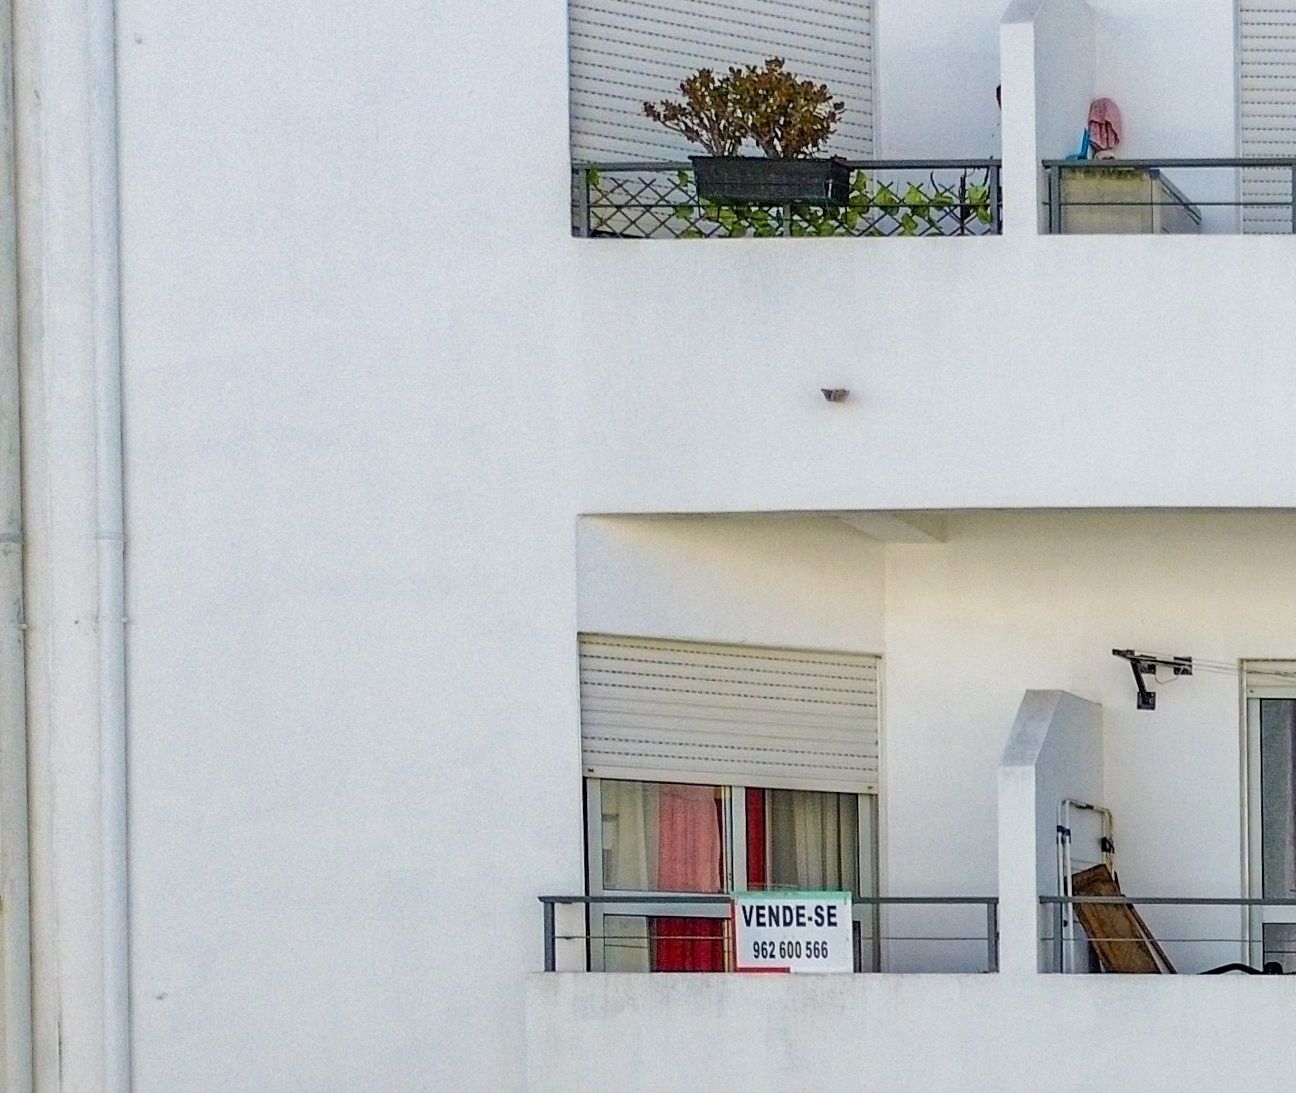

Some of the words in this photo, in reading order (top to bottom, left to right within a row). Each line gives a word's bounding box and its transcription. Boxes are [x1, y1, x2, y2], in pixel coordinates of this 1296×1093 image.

[742, 905, 837, 927] VENDE-SE
[753, 941, 776, 959] 962
[780, 941, 801, 959] 600
[806, 941, 828, 959] 566
